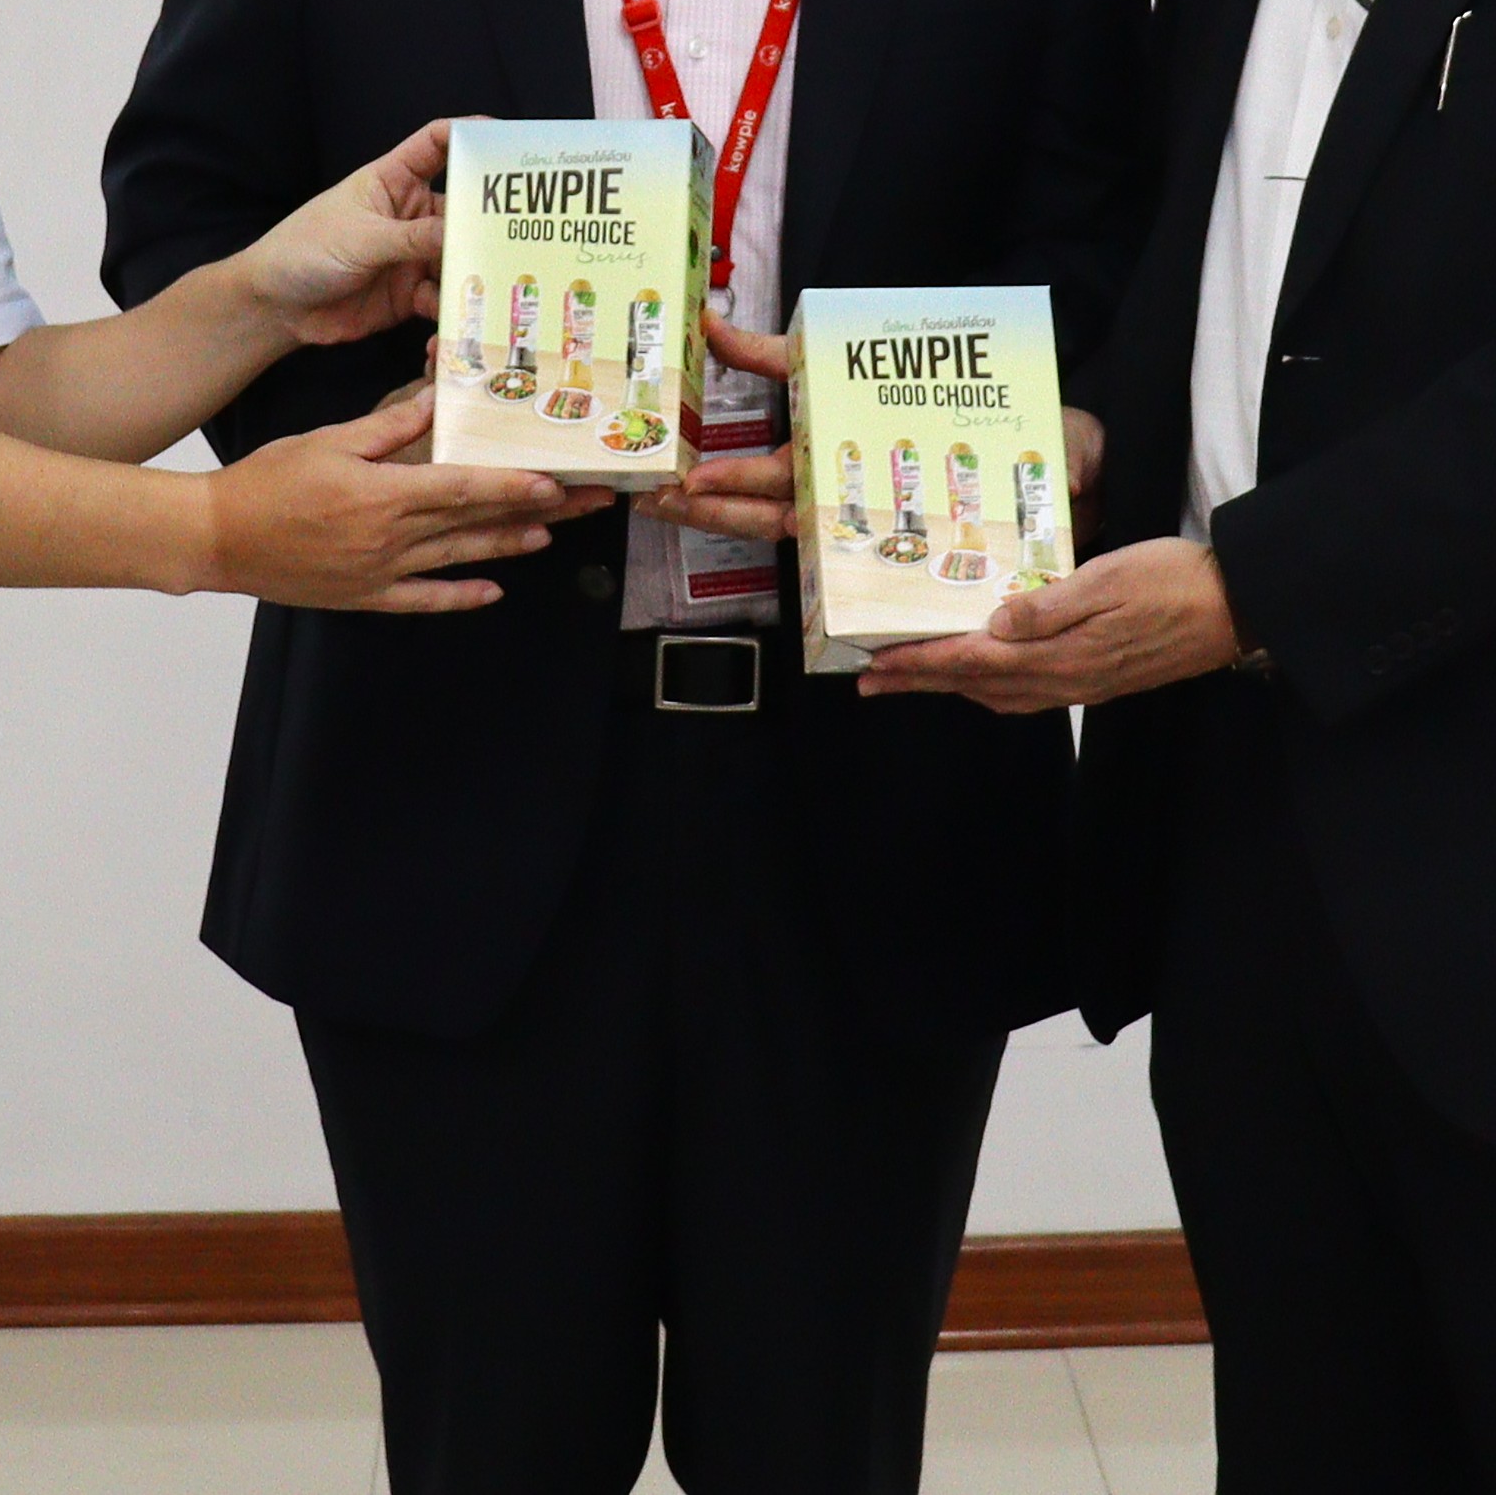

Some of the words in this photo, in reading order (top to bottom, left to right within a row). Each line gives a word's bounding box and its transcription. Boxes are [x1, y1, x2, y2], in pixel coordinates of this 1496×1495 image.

[724, 109, 757, 172] kewpie
[481, 167, 624, 214] KEWPIE
[508, 219, 554, 241] GOOD
[561, 220, 636, 245] CHOICE
[845, 333, 993, 380] KEWPIE
[878, 384, 926, 405] GOOD
[933, 385, 1011, 408] CHOICE
